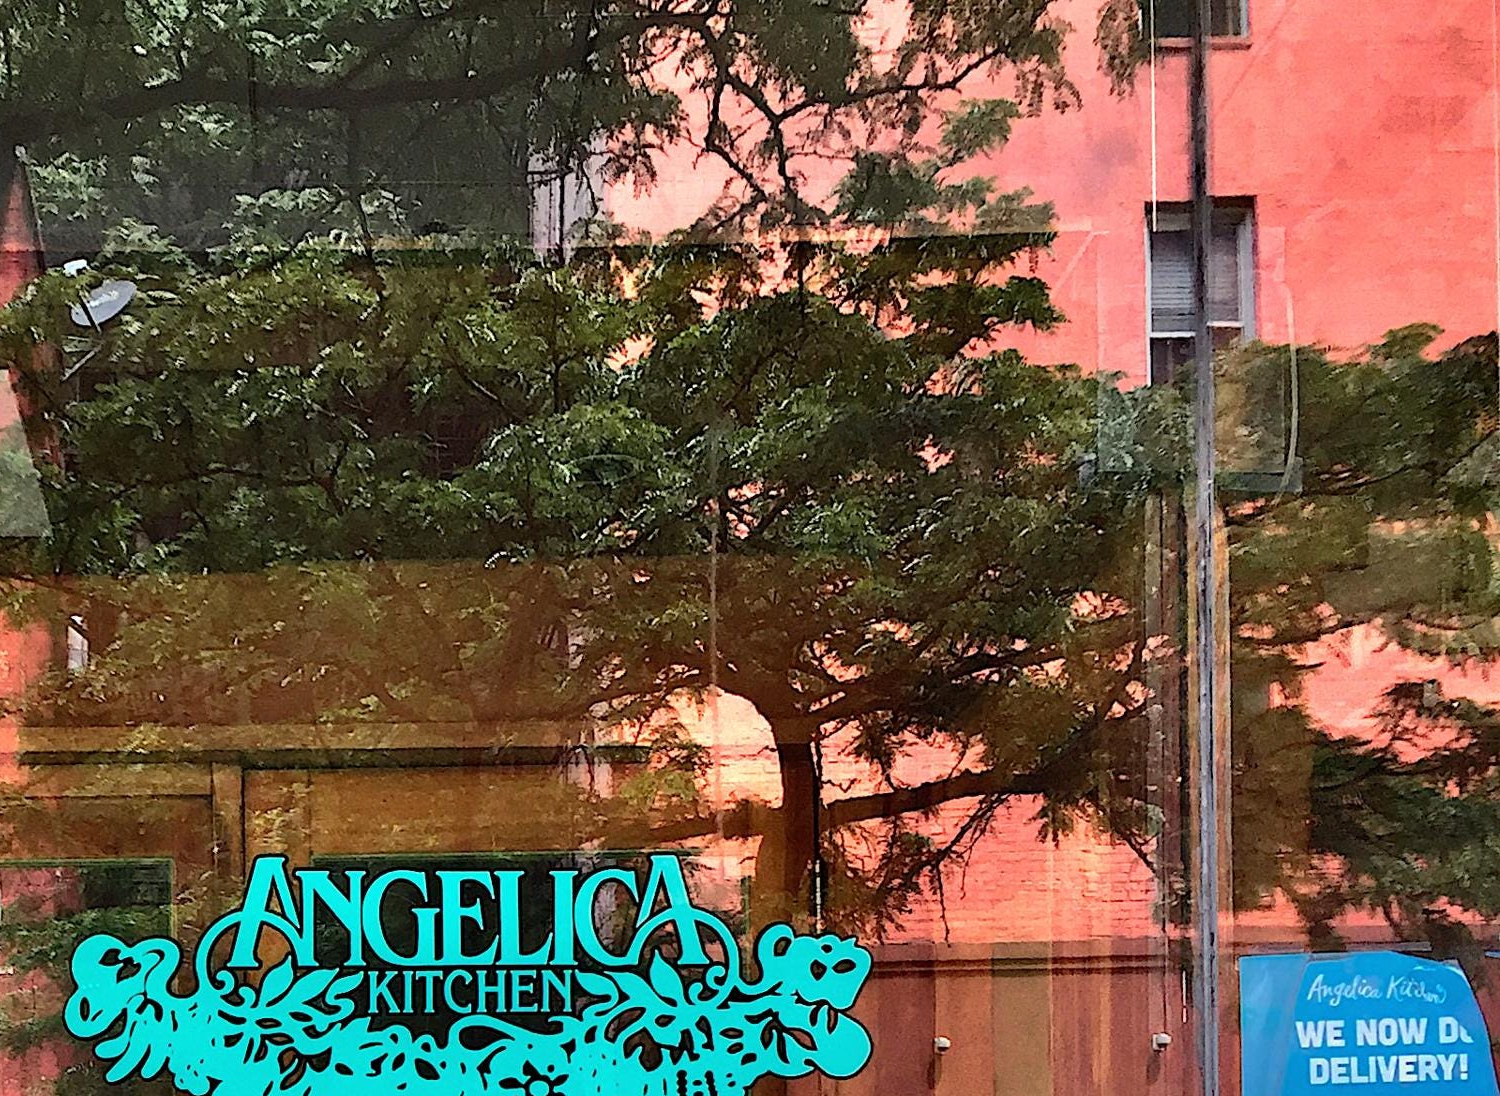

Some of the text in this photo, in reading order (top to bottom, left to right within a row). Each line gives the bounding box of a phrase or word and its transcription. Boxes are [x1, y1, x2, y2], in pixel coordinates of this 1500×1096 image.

[224, 853, 712, 968] ANGELICA
[367, 969, 576, 1014] KITCHEN
[1307, 974, 1382, 1007] Angelica
[1295, 1020, 1346, 1048] WE
[1355, 1017, 1428, 1046] NOW
[1309, 1053, 1468, 1085] DELIVERY!
